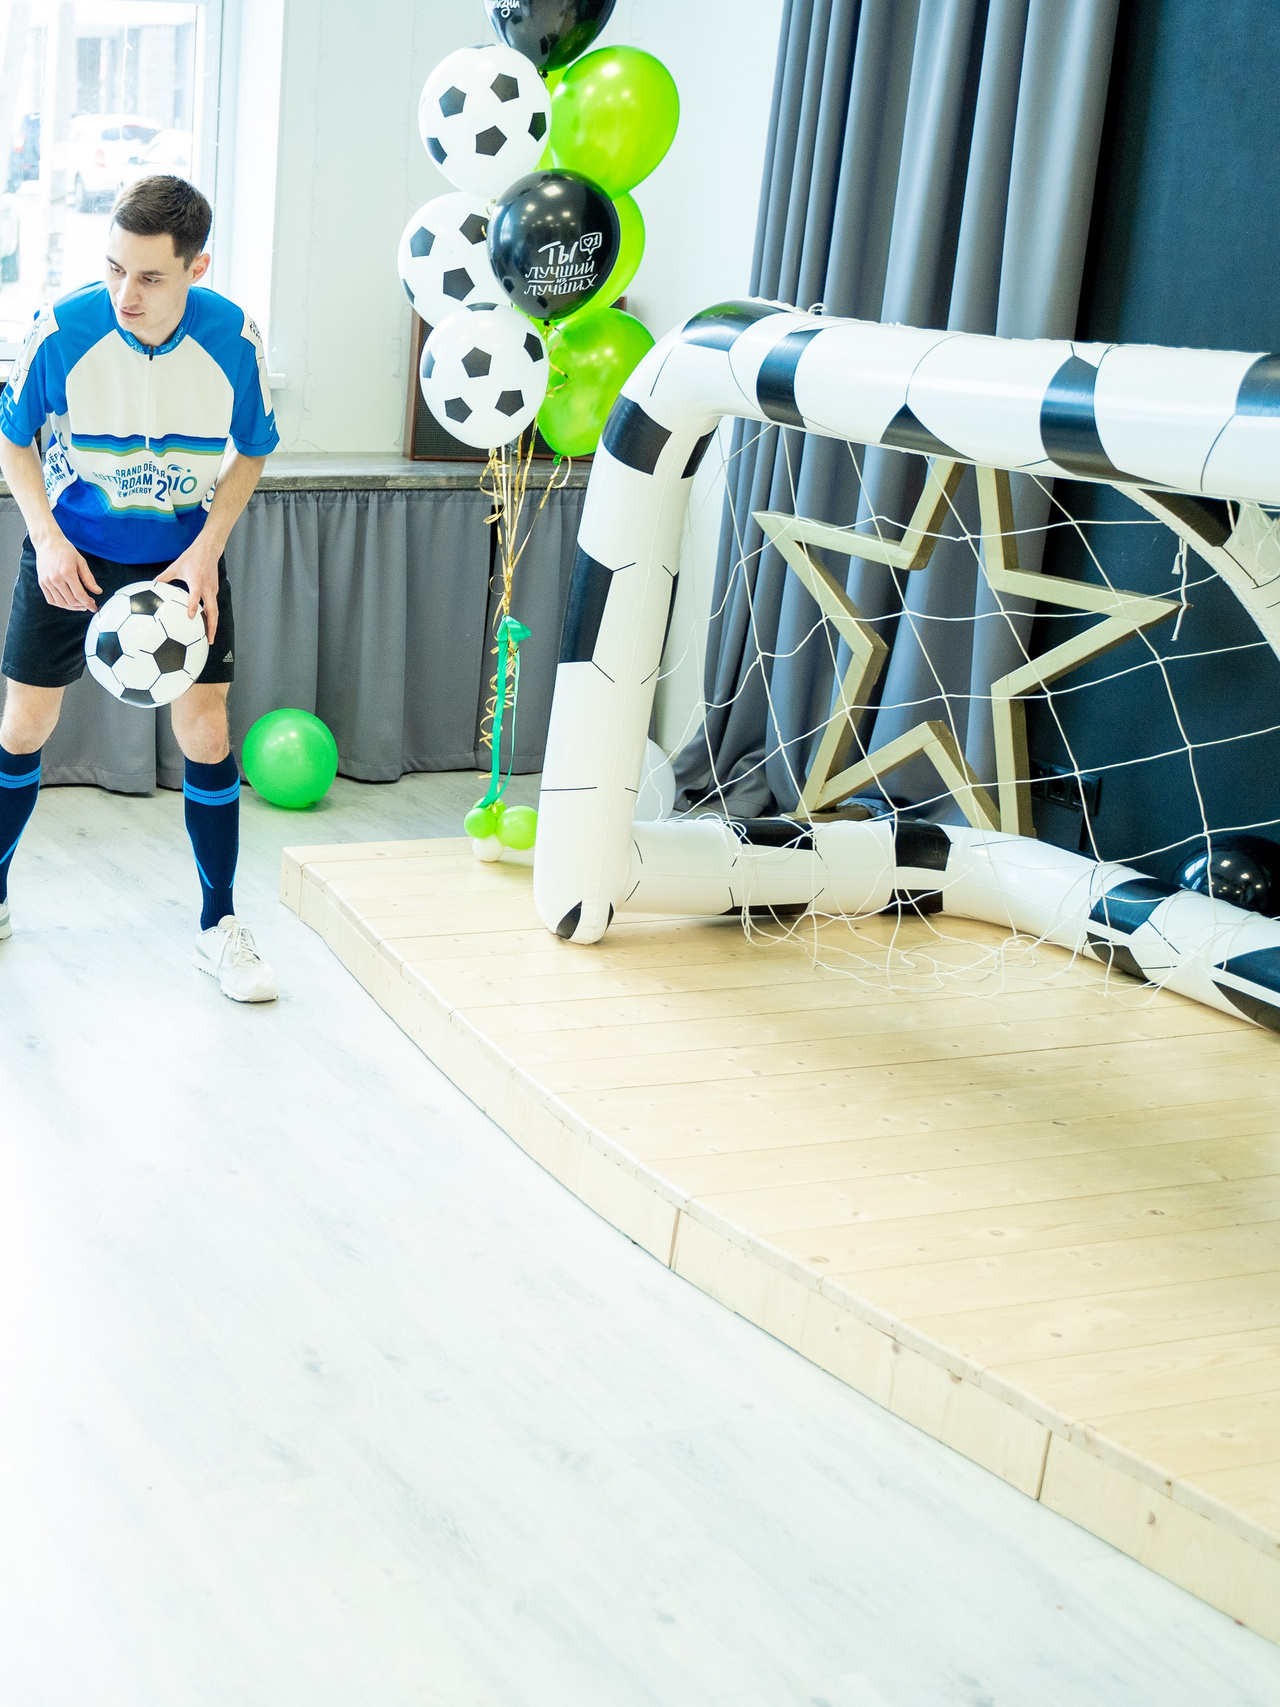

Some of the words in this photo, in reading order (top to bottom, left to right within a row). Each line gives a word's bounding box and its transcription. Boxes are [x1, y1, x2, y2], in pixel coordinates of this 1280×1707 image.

[524, 255, 595, 279] ЛУЧШИЙ
[523, 274, 598, 296] ЛУЧШИХ
[115, 464, 142, 478] GRAND
[143, 461, 166, 478] DÉPAR
